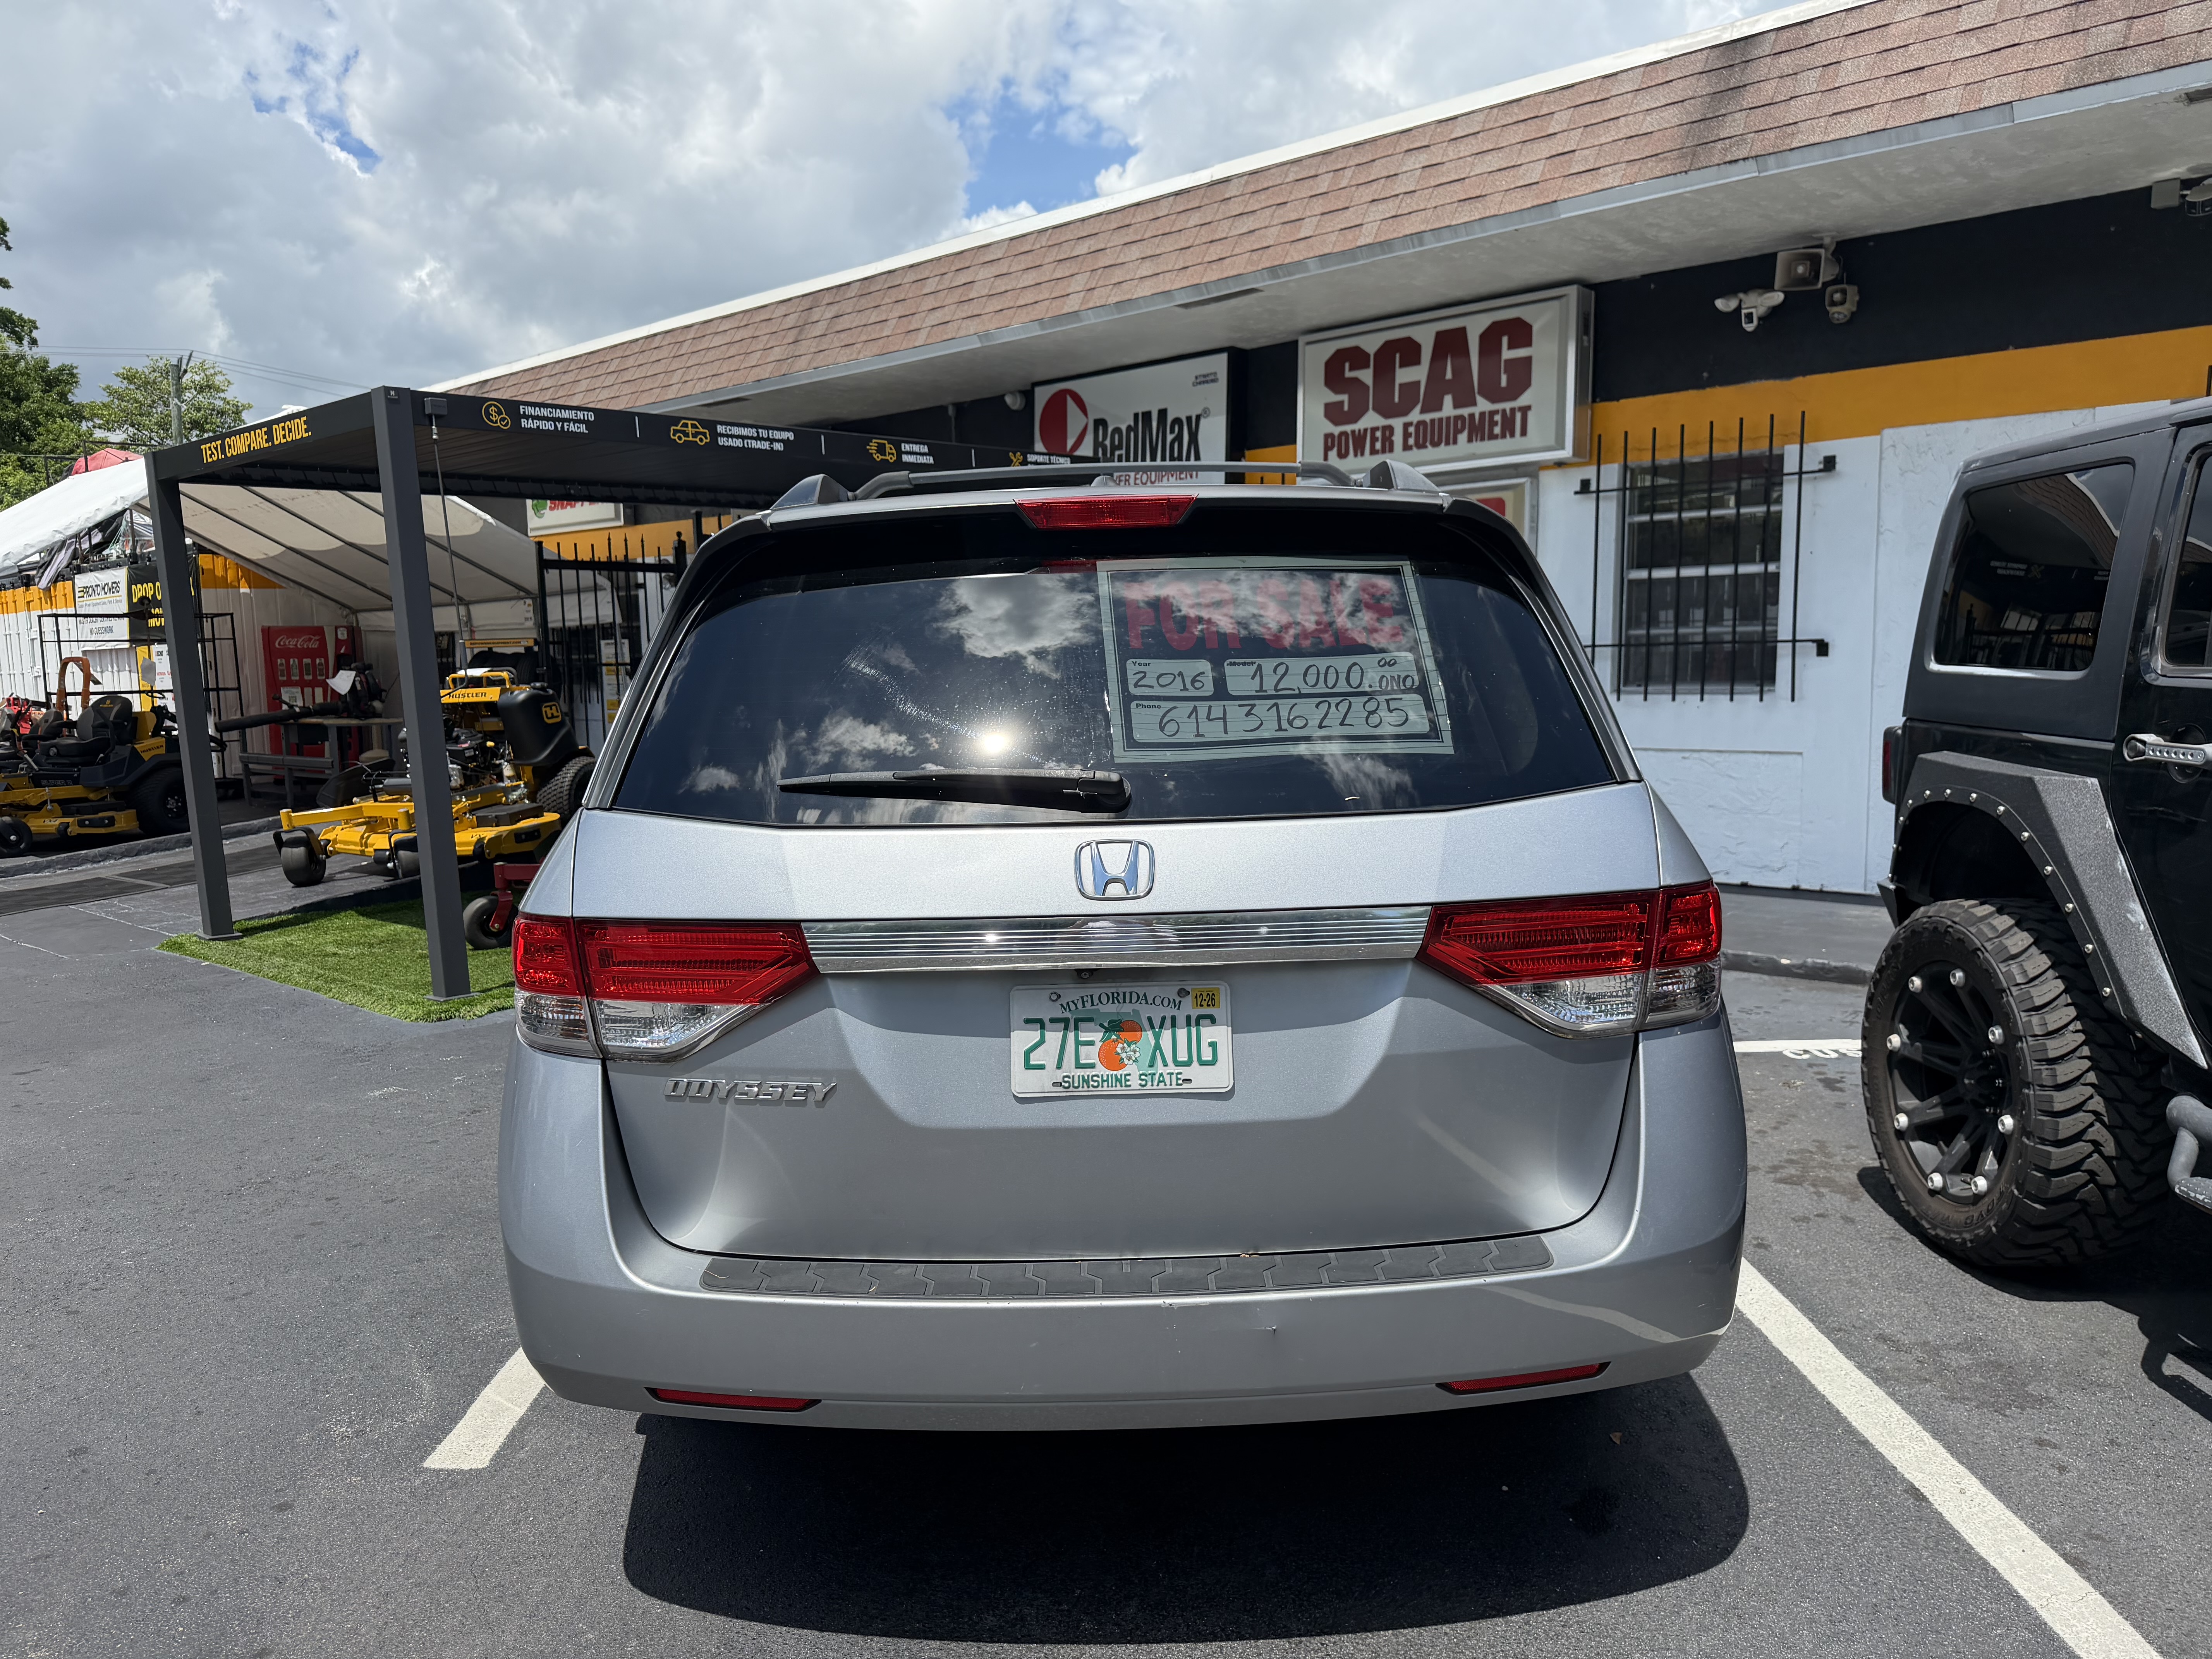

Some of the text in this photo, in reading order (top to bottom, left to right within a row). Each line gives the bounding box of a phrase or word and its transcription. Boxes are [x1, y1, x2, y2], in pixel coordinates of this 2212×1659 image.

[1324, 317, 1532, 426] SCAG
[520, 405, 594, 421] FINANCIAMIENTO
[521, 418, 588, 433] RÁPIDO Y FÁCIL
[716, 424, 794, 441] RECIBIMOS TU EQUIPO
[1093, 407, 1202, 463] RedMax
[1323, 405, 1532, 461] POWER EQUIPMENT
[201, 416, 311, 463] TEST. COMPARE. DECIDE.
[718, 437, 784, 451] USADO (TRADE-IN)
[901, 443, 929, 453] ENTREGA
[902, 453, 934, 464] INMEDIATA
[1125, 579, 1403, 650] FOR SALE
[1133, 671, 1205, 691] 2016
[1059, 991, 1183, 1014] MYFLORIDA.COM
[1194, 993, 1216, 1007] 12-26
[1023, 1013, 1218, 1070] 27E XUG
[663, 1078, 836, 1101] ODYSSEY
[1061, 1071, 1183, 1089] SUNSHINE STATE
